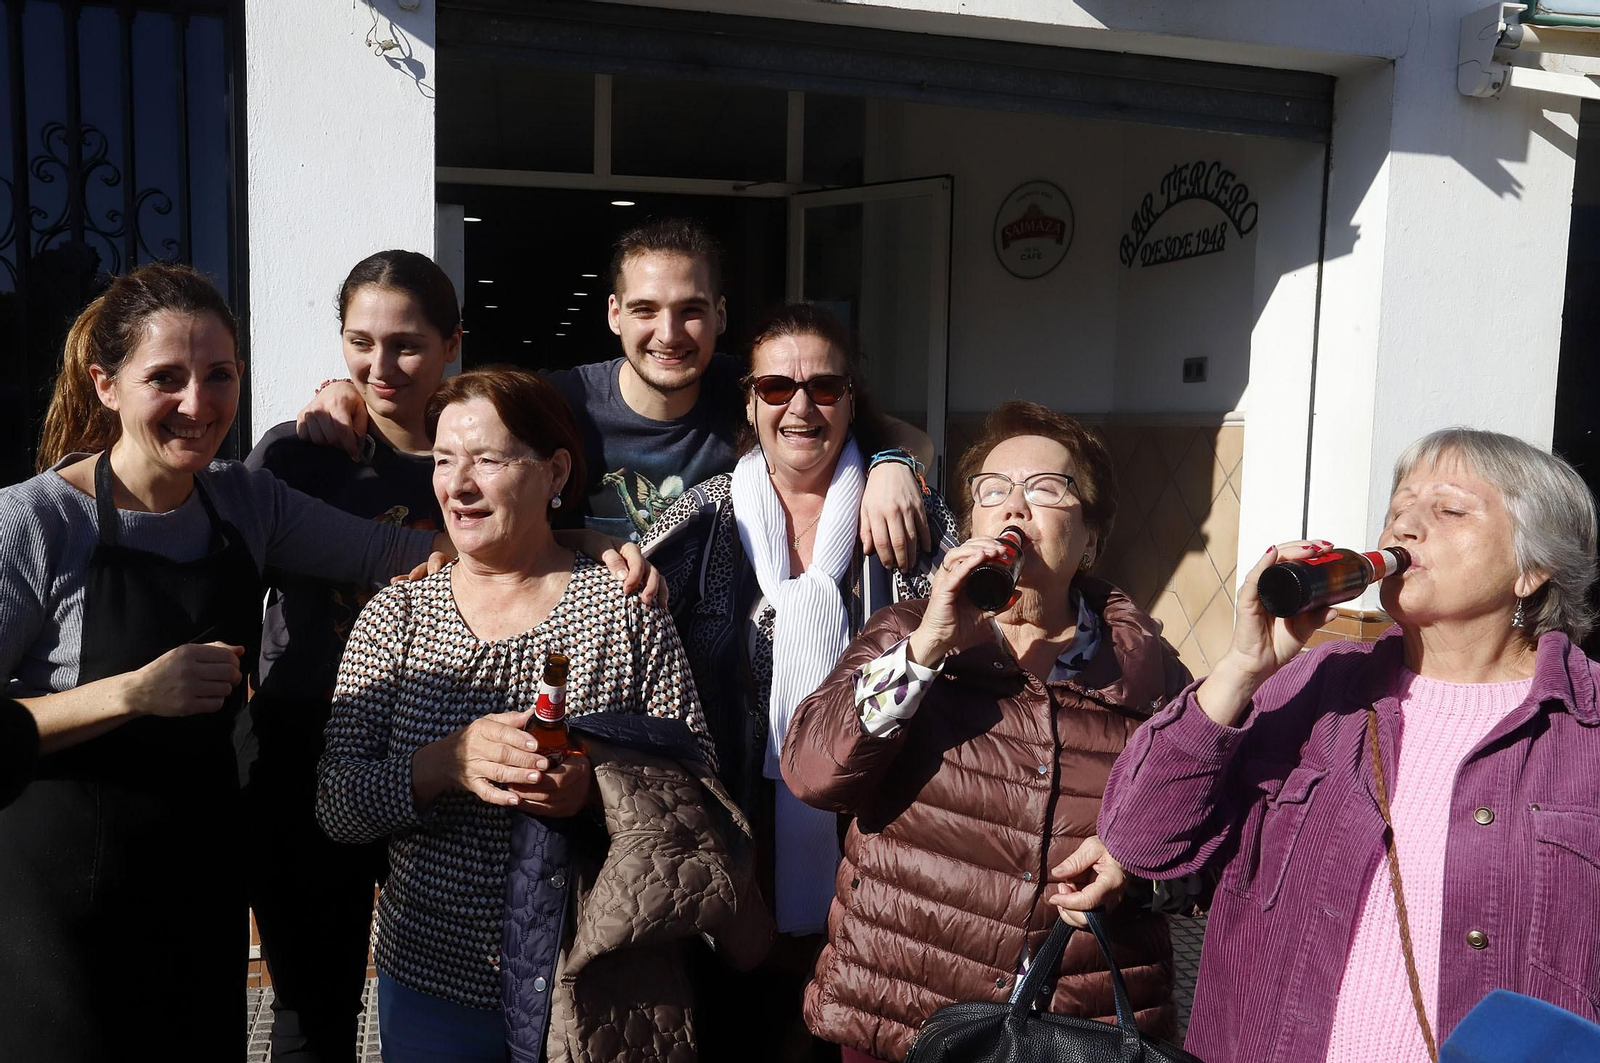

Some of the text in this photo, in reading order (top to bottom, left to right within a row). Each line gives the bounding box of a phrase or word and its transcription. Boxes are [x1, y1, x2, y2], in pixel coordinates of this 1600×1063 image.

[1004, 220, 1061, 239] SAIMAZA
[1120, 160, 1258, 268] BAR TERCERO
[1140, 221, 1228, 265] DESDE 1948
